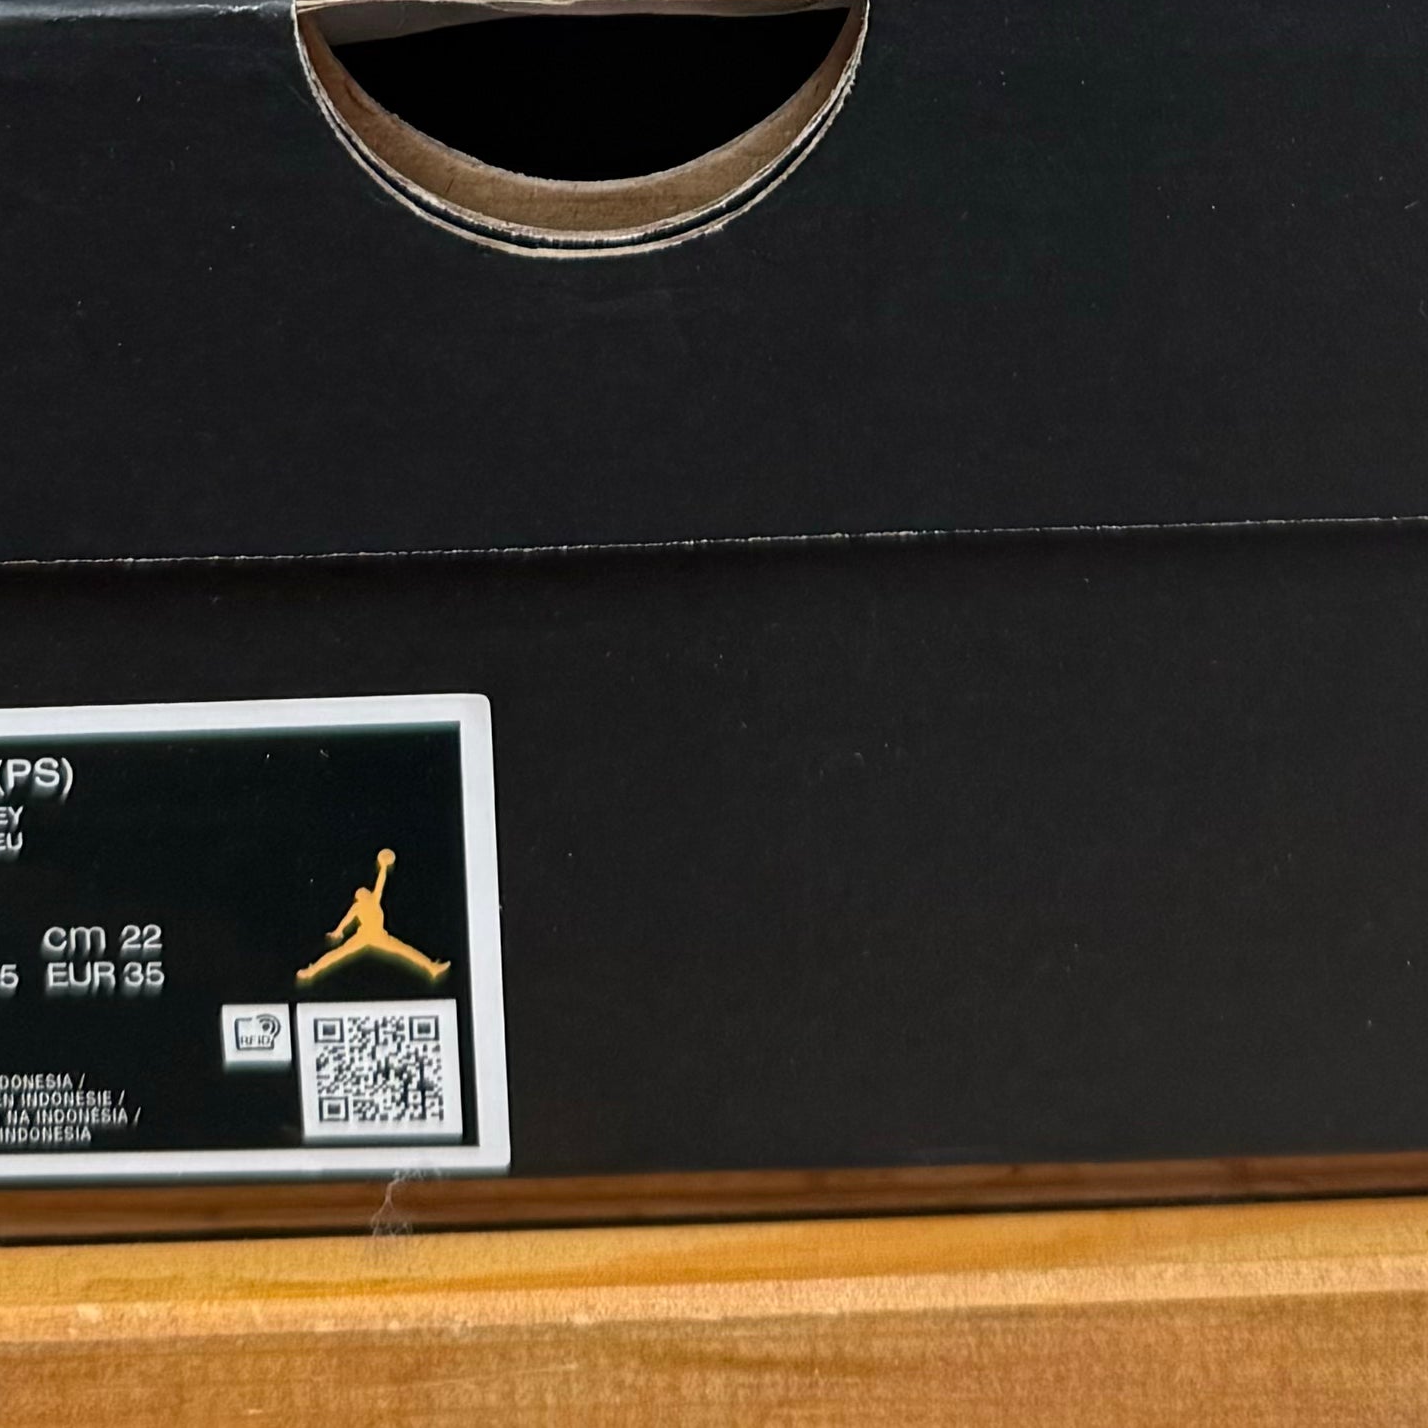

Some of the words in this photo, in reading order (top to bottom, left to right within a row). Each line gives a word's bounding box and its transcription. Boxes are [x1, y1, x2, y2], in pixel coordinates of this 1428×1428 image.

[42, 926, 107, 954] cm
[121, 924, 164, 950] 22
[47, 961, 116, 988] EUR
[123, 961, 166, 987] 35
[6, 1109, 31, 1127] NA
[0, 1125, 92, 1143] INDONESIA
